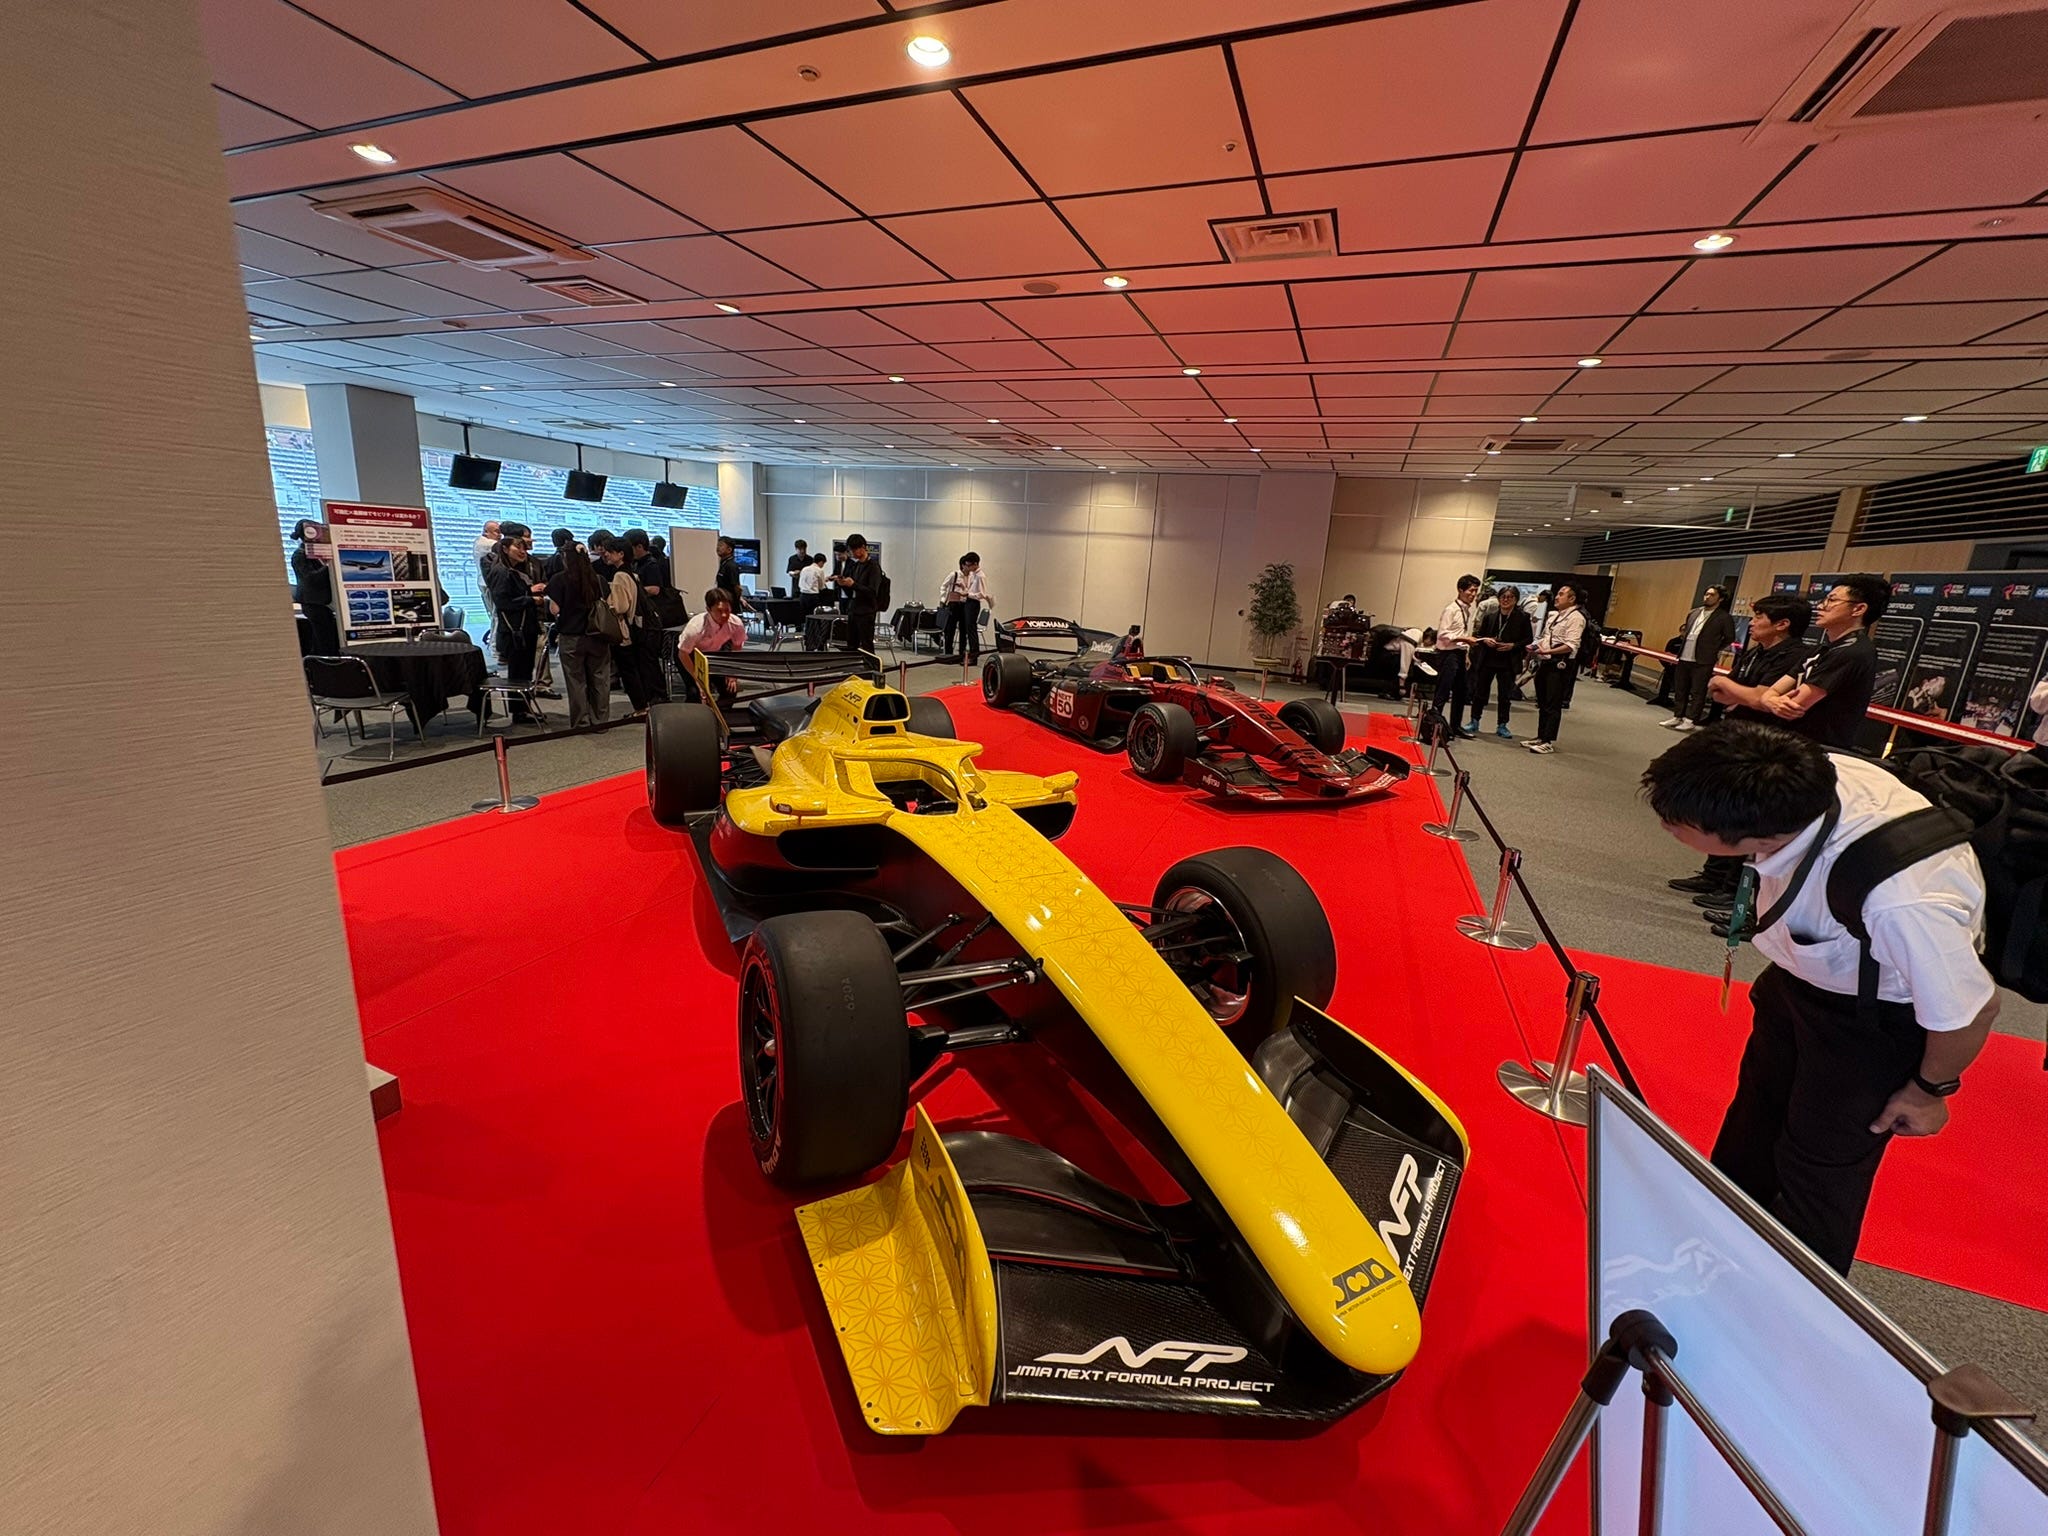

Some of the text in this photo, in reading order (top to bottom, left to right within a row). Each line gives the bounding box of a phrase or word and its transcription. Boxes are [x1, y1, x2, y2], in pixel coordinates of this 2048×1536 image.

[1058, 699, 1072, 716] 50
[1410, 1203, 1434, 1258] FORMULA
[1033, 1336, 1249, 1373] NFP
[1008, 1365, 1275, 1393] JMIA NEXT FORMULA PROJECT
